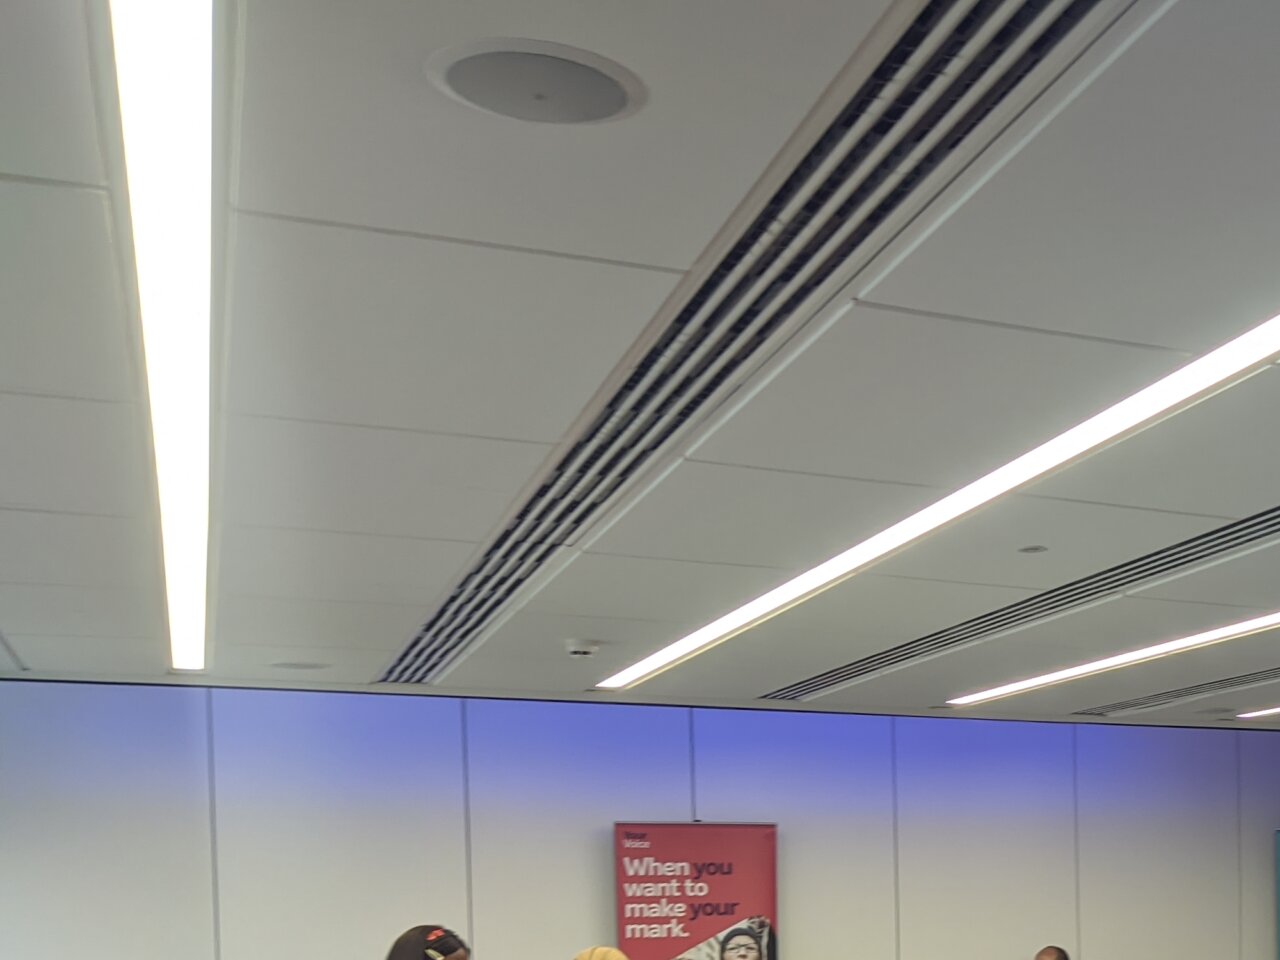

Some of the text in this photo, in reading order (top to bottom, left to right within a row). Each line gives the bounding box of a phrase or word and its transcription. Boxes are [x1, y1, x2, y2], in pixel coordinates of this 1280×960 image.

[623, 857, 733, 879] When you
[623, 879, 709, 896] want to
[624, 898, 740, 920] make your
[625, 919, 690, 938] mark.
